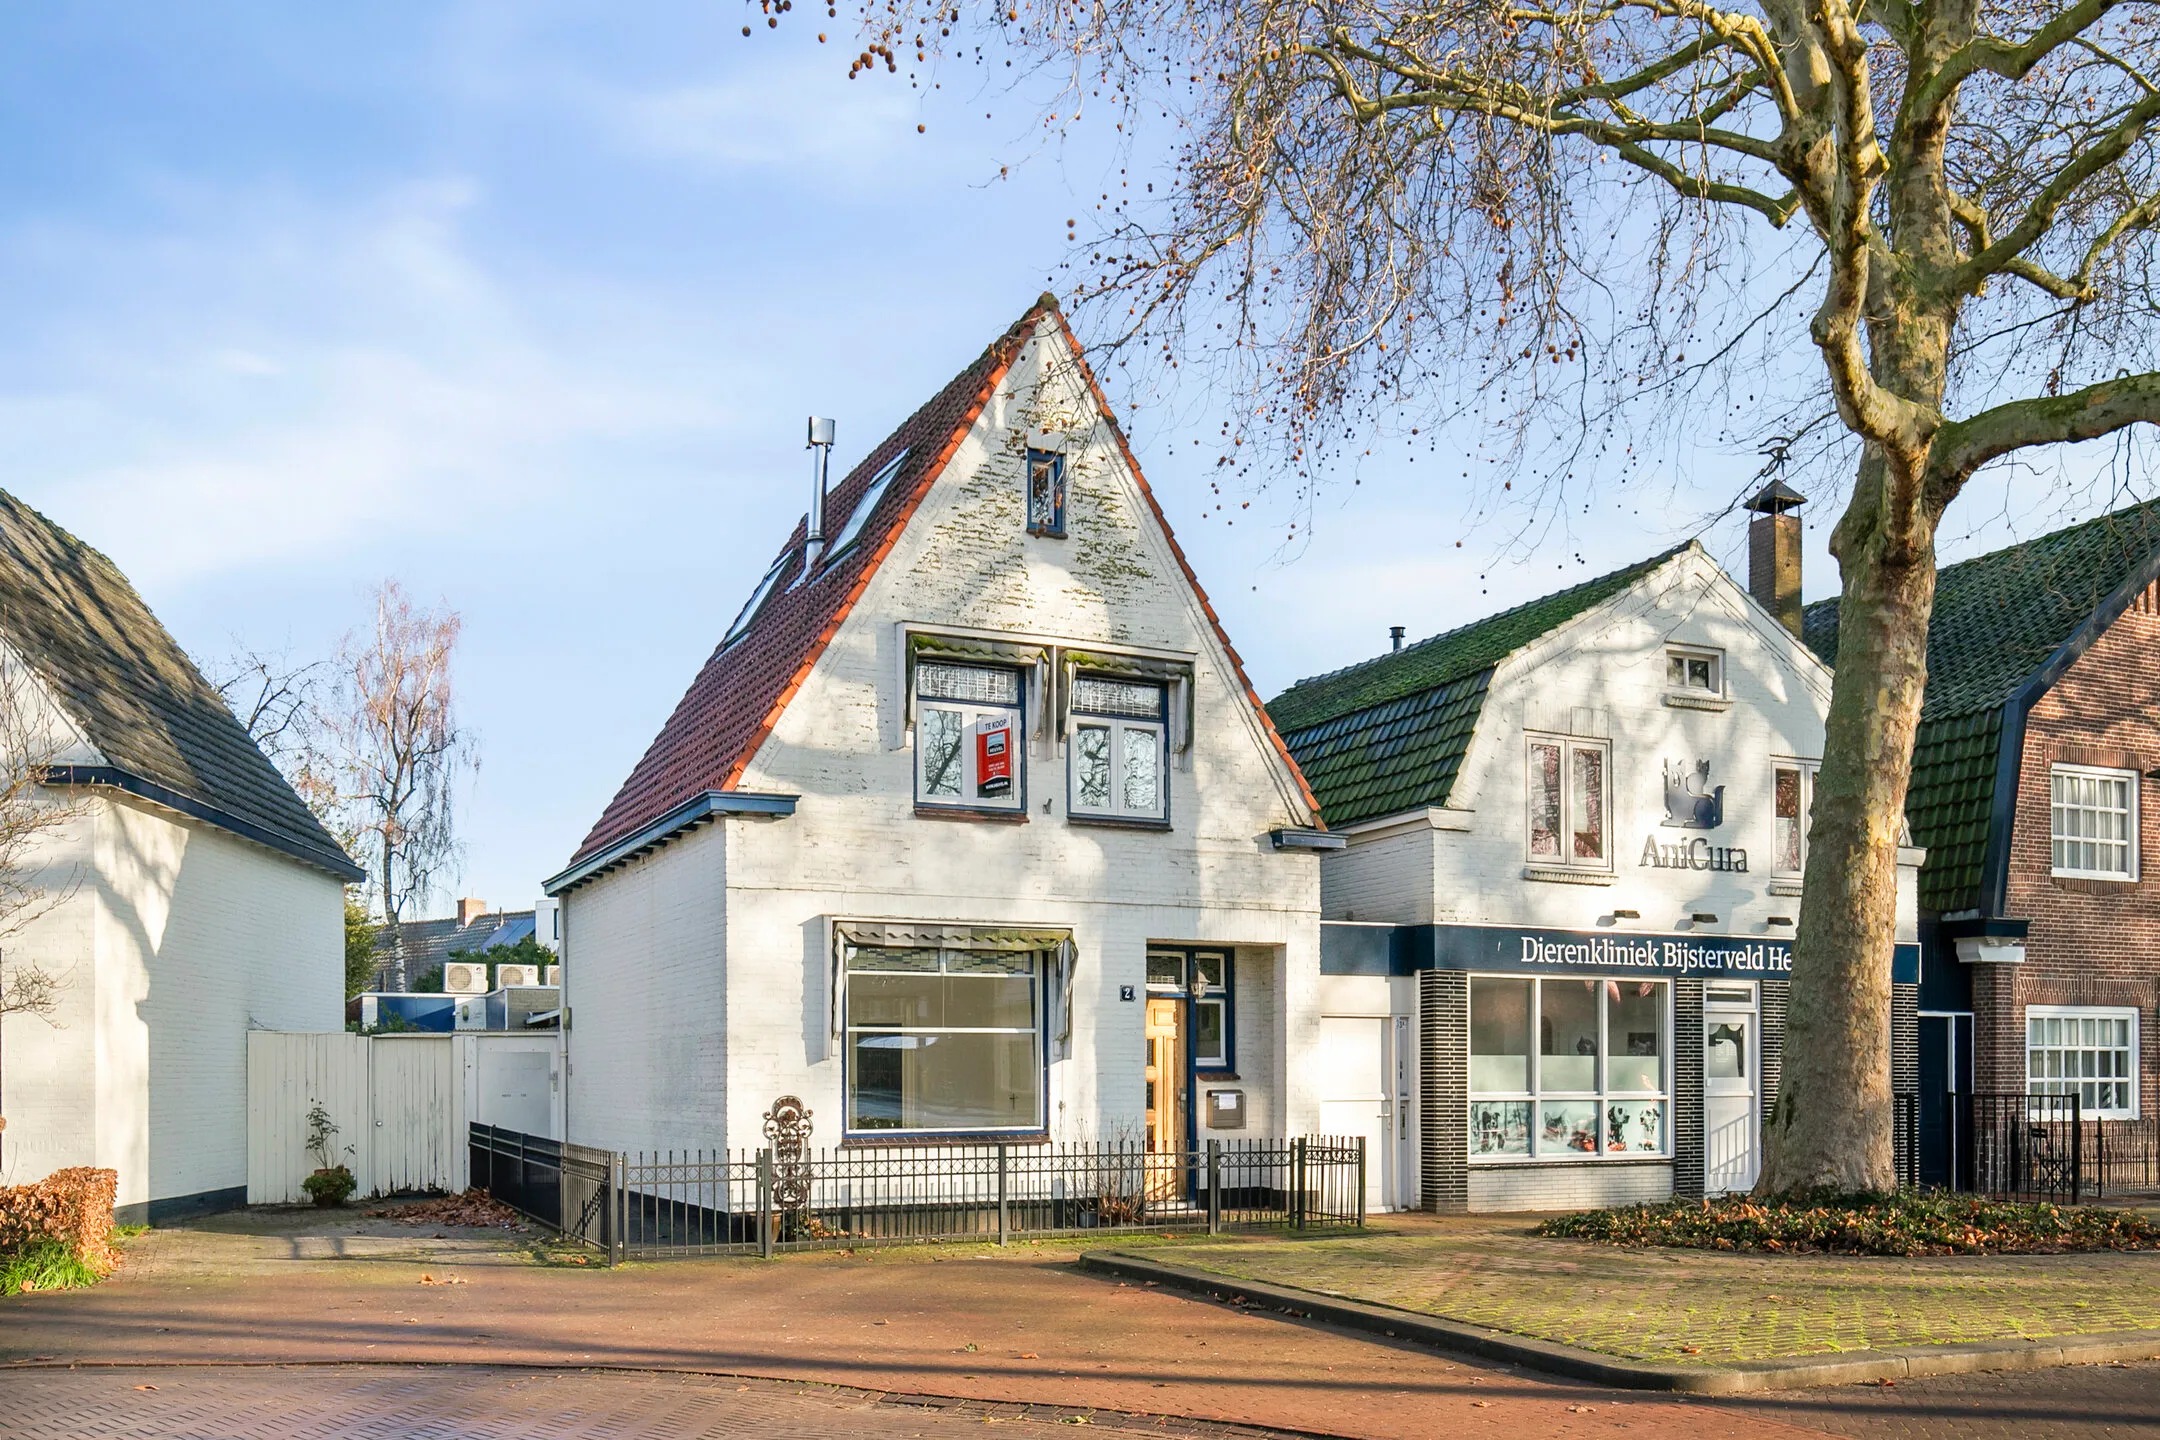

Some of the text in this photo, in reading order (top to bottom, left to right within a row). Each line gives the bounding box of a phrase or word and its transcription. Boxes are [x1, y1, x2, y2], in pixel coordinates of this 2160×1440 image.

[985, 719, 1006, 730] TE KOOP
[1638, 834, 1749, 873] AniCura
[1521, 937, 1659, 967] Dierenkliniek
[1662, 942, 1765, 974] Bijsterveld
[1125, 987, 1131, 999] 2
